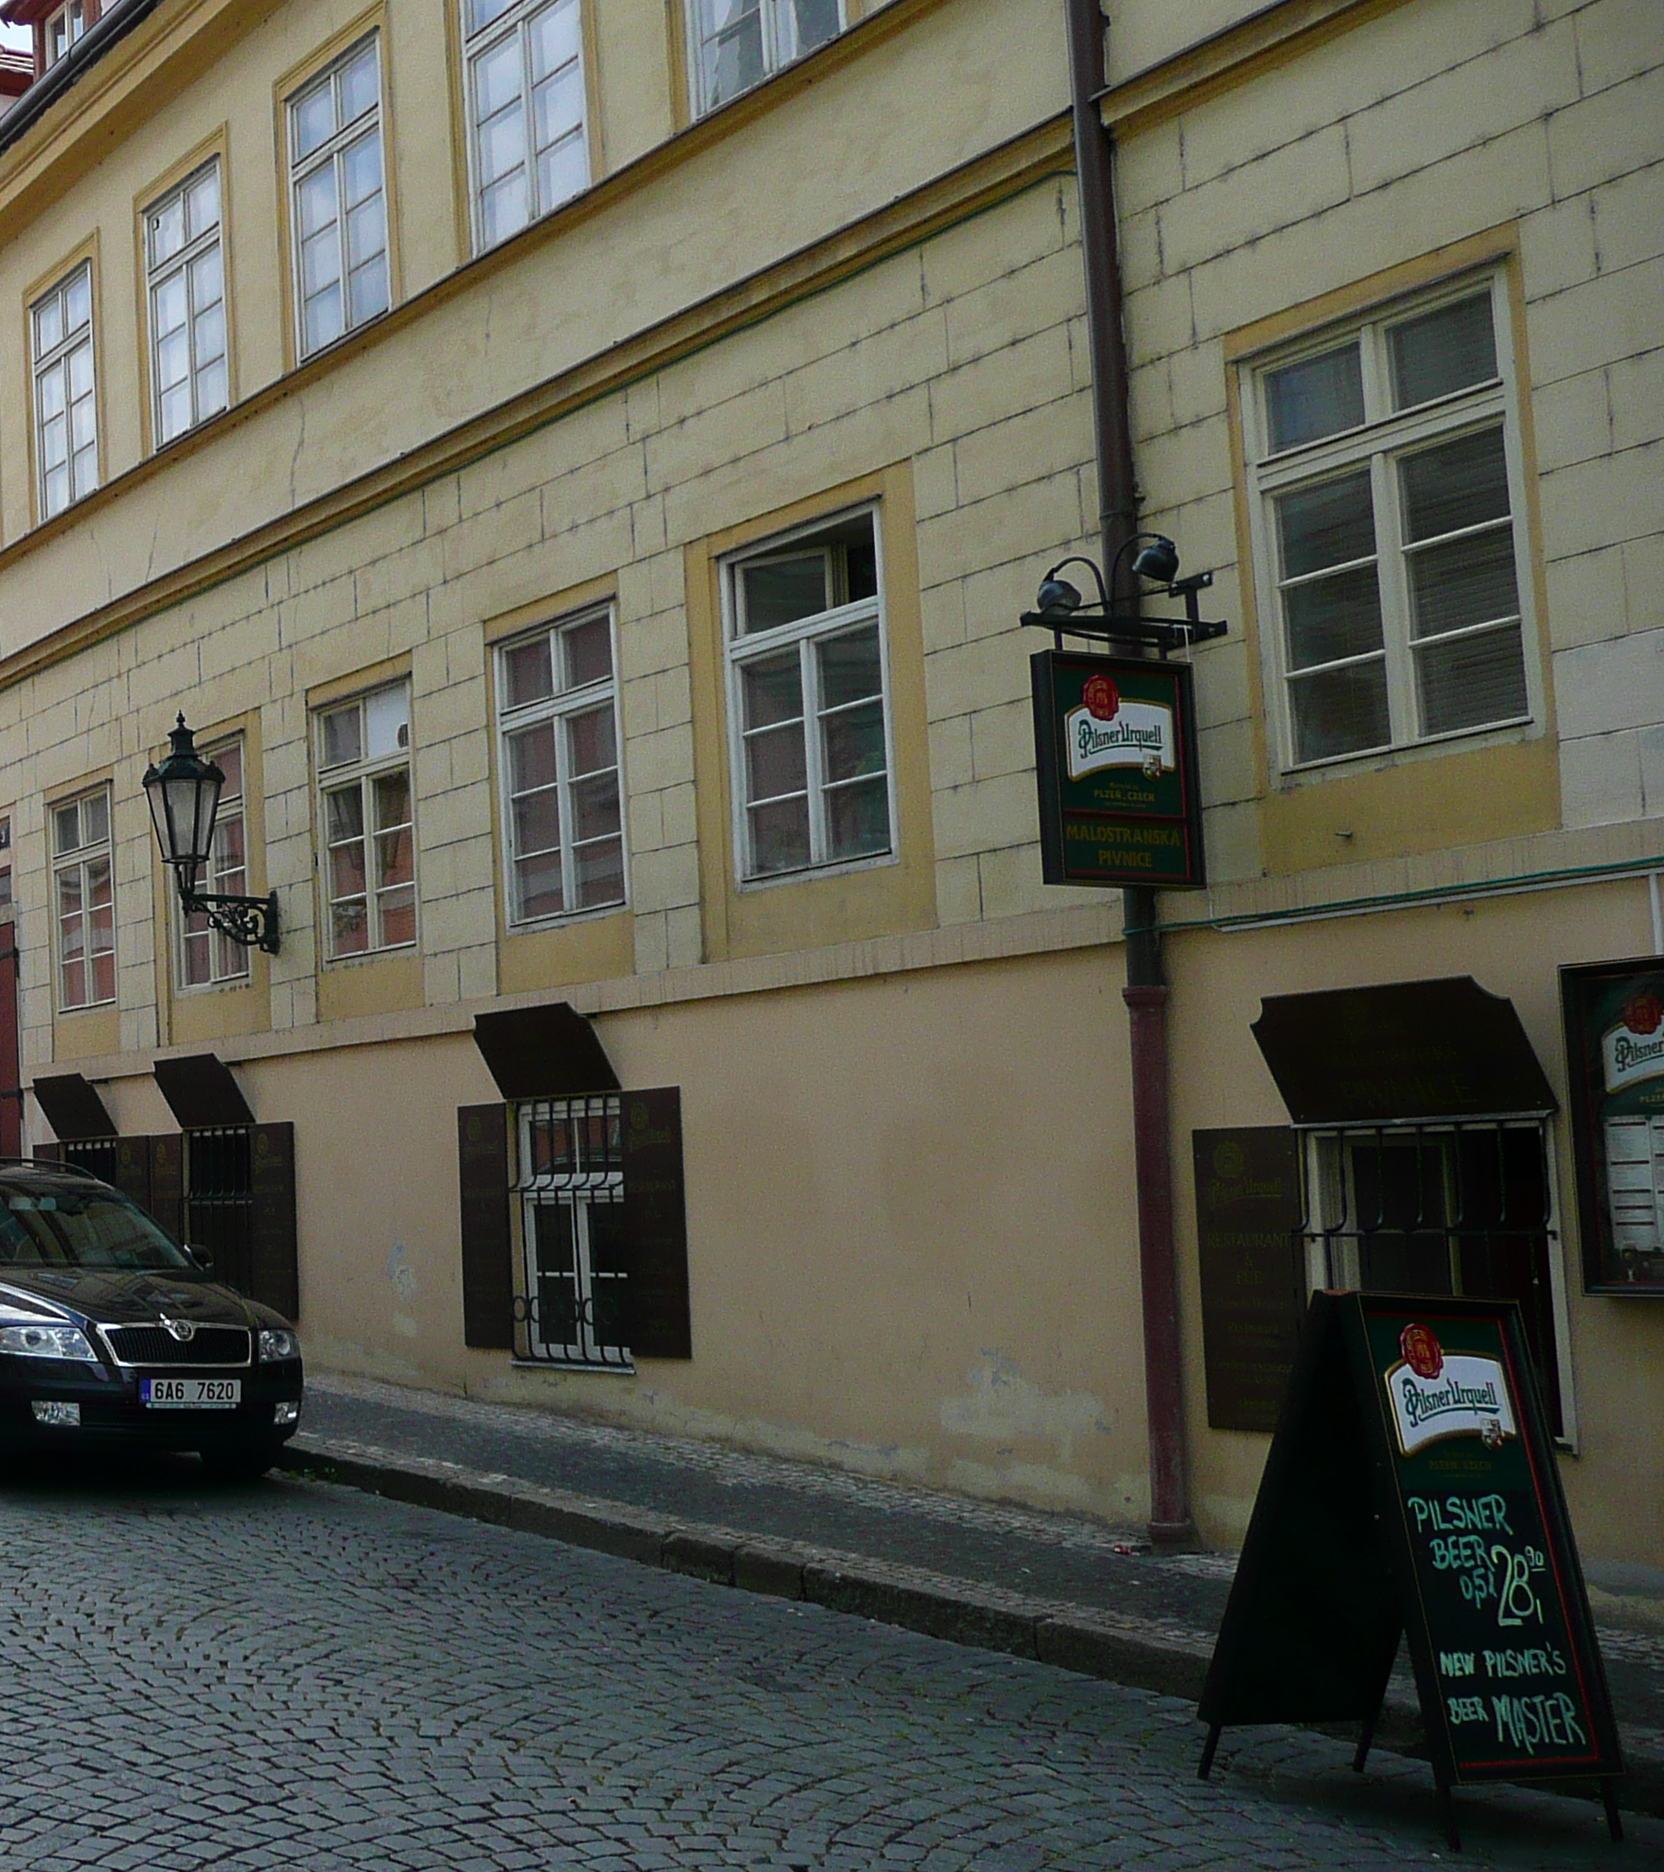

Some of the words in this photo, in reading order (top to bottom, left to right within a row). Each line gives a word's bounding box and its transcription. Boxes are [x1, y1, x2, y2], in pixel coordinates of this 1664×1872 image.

[1078, 718, 1120, 759] Pilsner
[1119, 721, 1162, 751] Urquell
[1098, 850, 1153, 868] PIVNICE
[1614, 1035, 1664, 1073] Pilsner
[1206, 1231, 1293, 1249] RESTAURANT
[155, 1382, 185, 1400] 6A6
[197, 1382, 234, 1400] 7620
[1402, 1378, 1451, 1428] Pilsner
[1447, 1377, 1498, 1415] Urquell
[1407, 1493, 1515, 1536] PILSNER
[1429, 1534, 1496, 1572] BEER
[1439, 1650, 1477, 1678] NEW
[1482, 1640, 1567, 1679] PILSNER'S
[1447, 1695, 1490, 1725] BEER
[1491, 1691, 1588, 1757] MASTER
